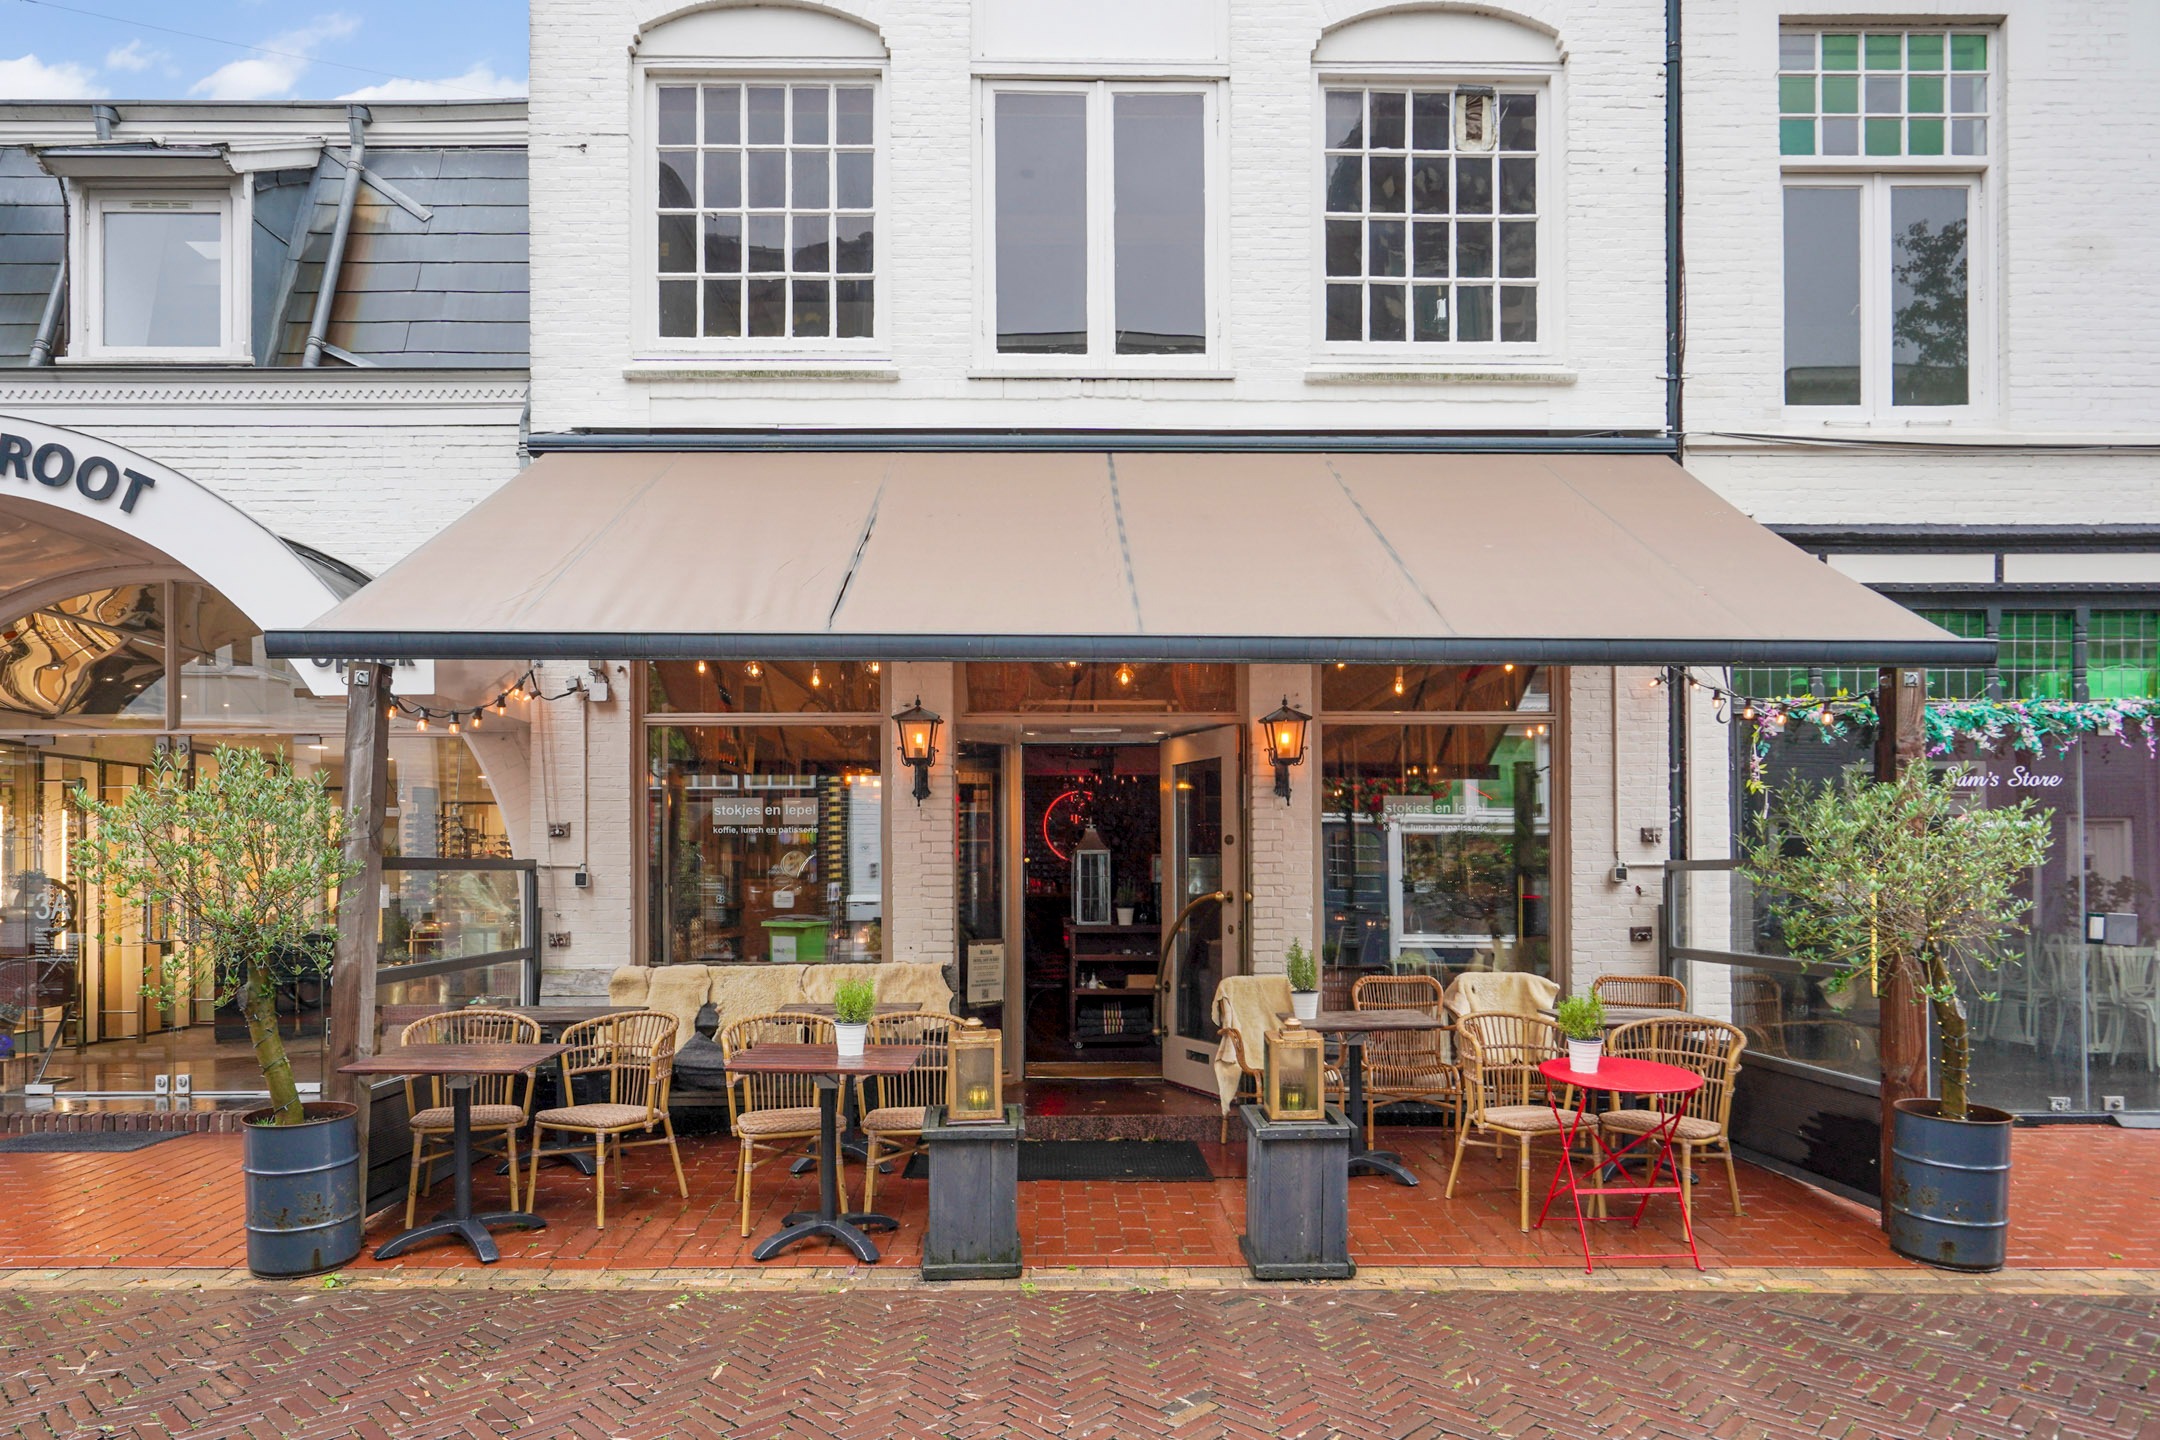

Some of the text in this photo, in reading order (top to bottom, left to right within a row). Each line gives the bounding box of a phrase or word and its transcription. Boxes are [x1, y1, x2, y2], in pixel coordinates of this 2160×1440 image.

[0, 432, 156, 514] ROOT
[2007, 765, 2063, 787] Store
[714, 804, 817, 818] stokjes en lepel
[1385, 802, 1432, 815] stokjes
[1435, 804, 1451, 814] en
[712, 825, 739, 835] koffie,
[741, 826, 764, 834] lunch
[778, 825, 819, 835] patisserie
[35, 892, 71, 919] 3A
